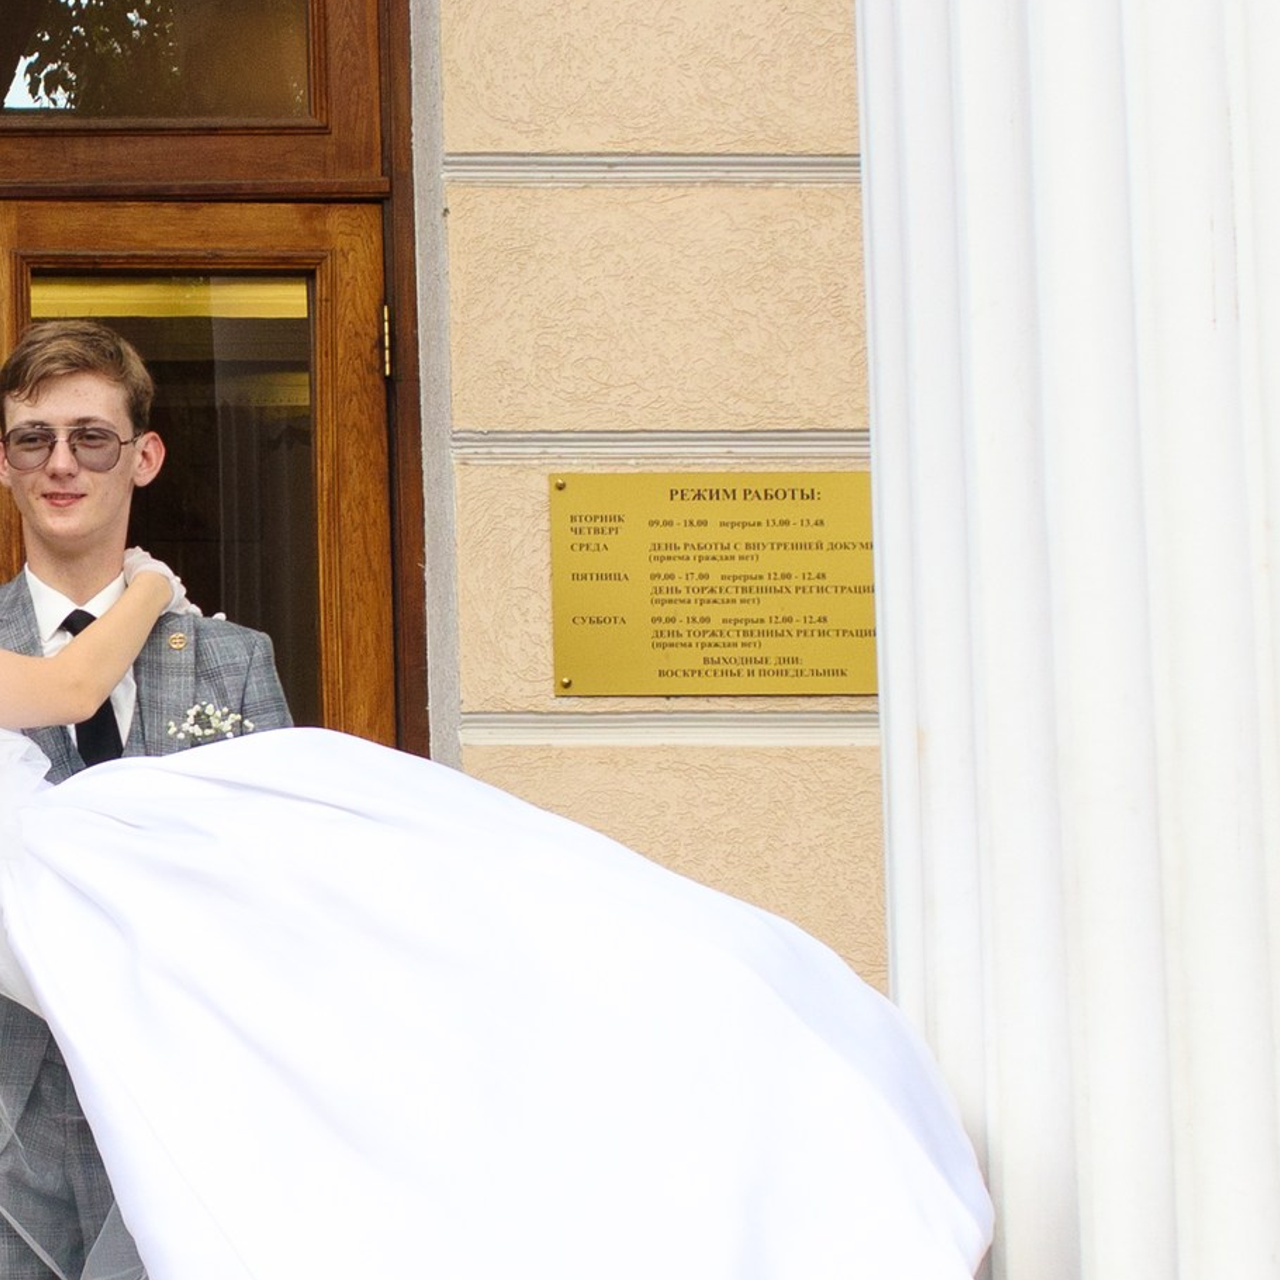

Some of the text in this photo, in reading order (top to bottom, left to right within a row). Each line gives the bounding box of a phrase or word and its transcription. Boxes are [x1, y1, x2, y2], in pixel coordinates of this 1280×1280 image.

[669, 488, 822, 501] РЕЖИМ РАБОТЫ:
[570, 514, 625, 523] ВТОРНИК
[648, 519, 674, 528] 09.00
[683, 519, 709, 528] 18.00
[570, 526, 621, 536] ЧЕТВЕРГ
[570, 542, 609, 552] СРЕДА
[648, 542, 681, 552] ДЕНЬ
[683, 542, 730, 551] РАБОТЫ
[733, 542, 741, 551] С
[744, 540, 824, 551] ВНУТРЕННЕЙ
[571, 572, 629, 582] ПЯТНИЦА
[649, 573, 675, 581] 09.00
[685, 573, 710, 581] 17.00
[650, 586, 682, 595] ДЕНЬ
[684, 585, 792, 594] ТОРЖЕСТВЕННЫХ
[571, 616, 627, 625] СУББОТА
[650, 616, 676, 624] 09.00
[686, 616, 711, 624] 18.00
[651, 630, 683, 639] ДЕНЬ
[686, 629, 793, 638] ТОРЖЕСТВЕННЫХ
[702, 656, 803, 666] ВЫХОДНЫЕ ДНИ:
[657, 669, 848, 678] ВОСКРЕСЕНЬЕ И ПОНЕДЕЛЬНИК
